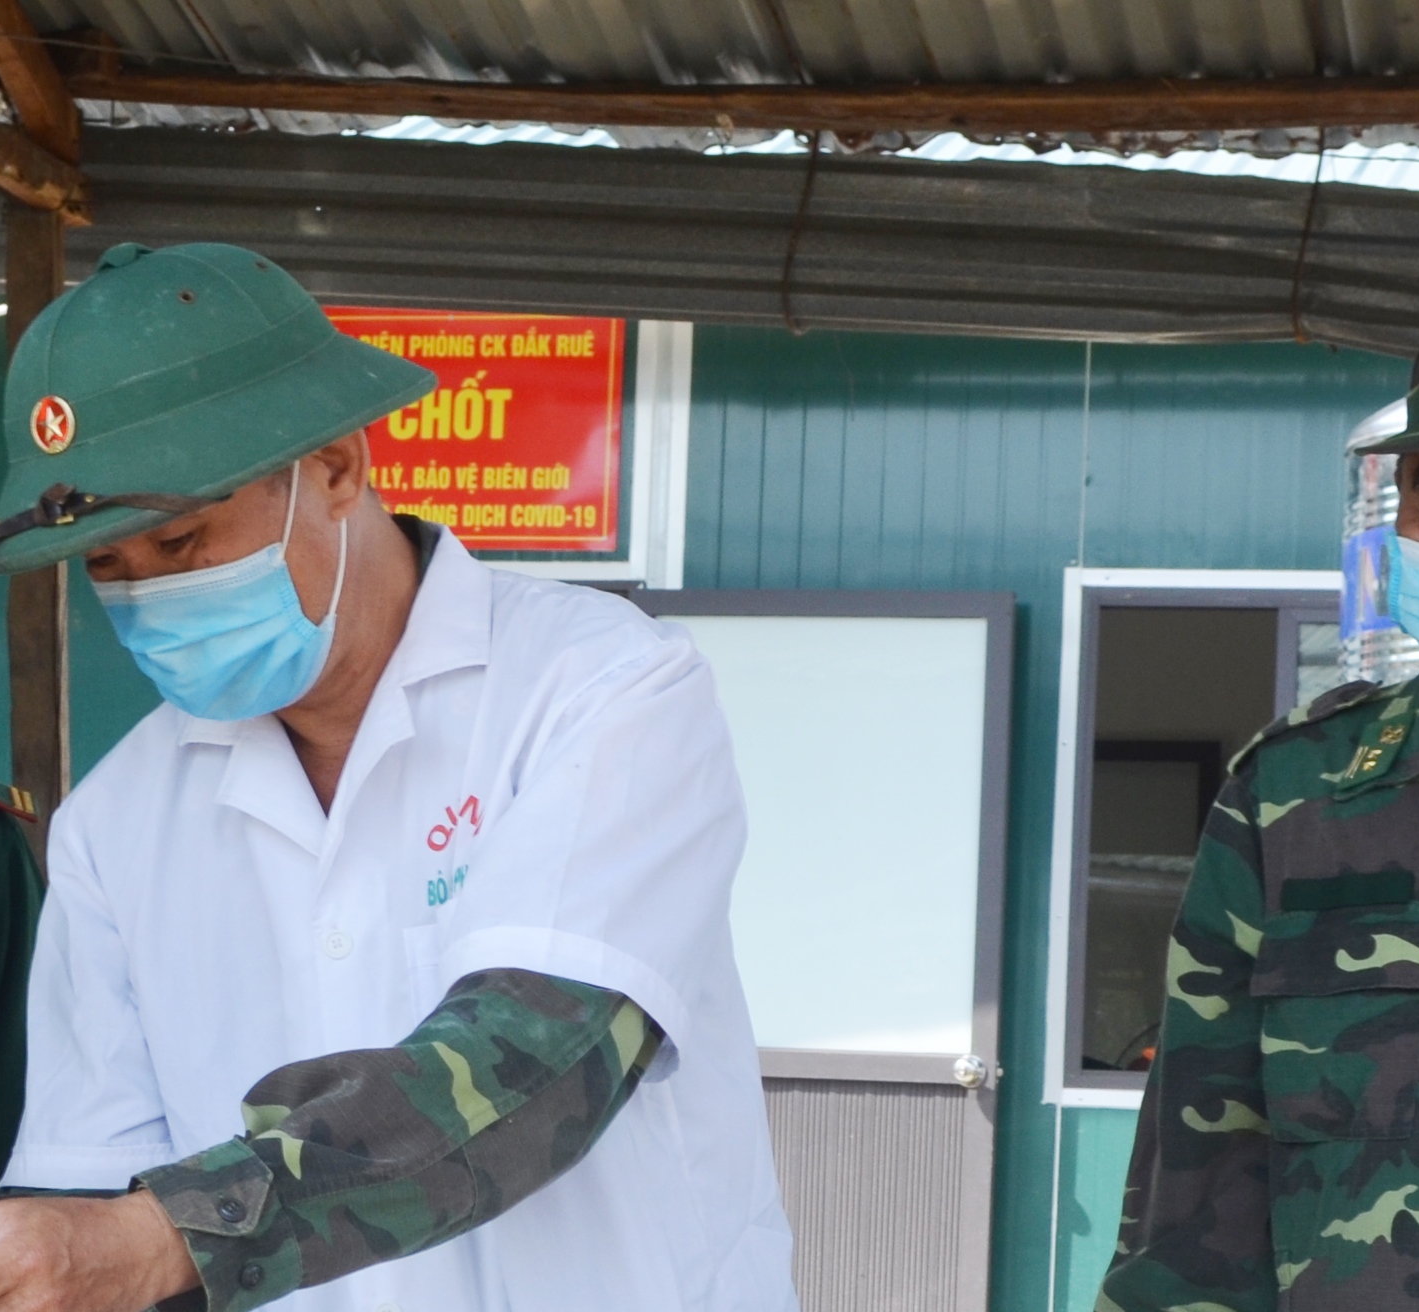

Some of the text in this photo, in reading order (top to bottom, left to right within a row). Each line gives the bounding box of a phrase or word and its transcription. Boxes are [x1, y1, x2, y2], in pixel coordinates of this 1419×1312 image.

[409, 330, 475, 357] PHÒNG
[480, 335, 507, 357] CK
[556, 330, 595, 357] RUÊ
[388, 369, 513, 440] CHỐT
[382, 462, 408, 491] LÝ,
[413, 459, 451, 489] BẢO
[456, 462, 478, 494] VỆ
[483, 462, 527, 489] BIÊN
[532, 462, 570, 489] GIỚI
[462, 504, 506, 532] DỊCH
[511, 504, 596, 528] COVID-19
